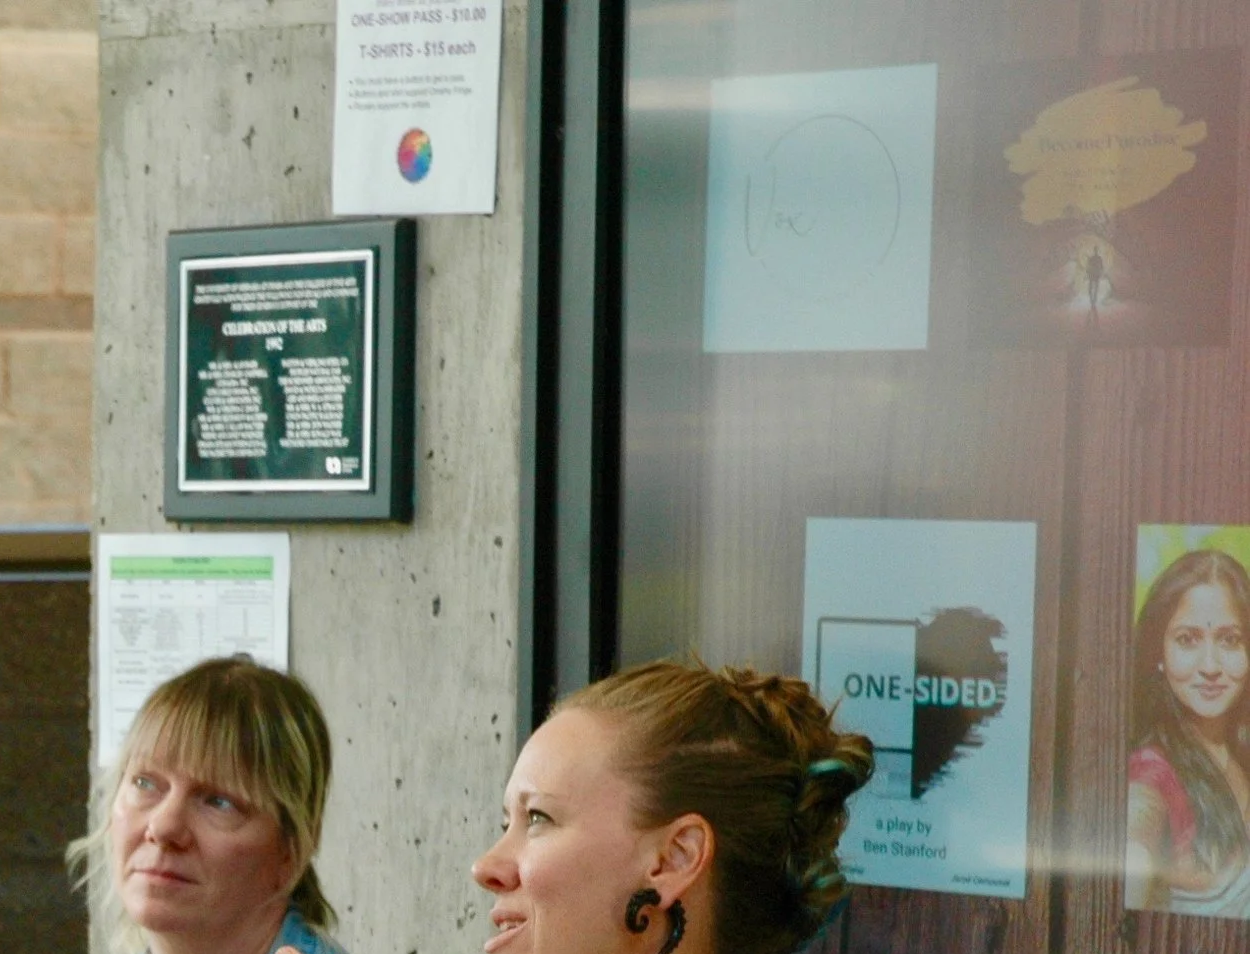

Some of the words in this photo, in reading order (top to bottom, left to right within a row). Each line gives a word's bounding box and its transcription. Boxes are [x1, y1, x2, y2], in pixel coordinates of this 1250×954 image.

[351, 11, 410, 27] ONE-SHOW
[413, 9, 442, 24] PASS
[451, 7, 486, 22] $10.00
[359, 42, 414, 59] T-SHIRTS
[423, 40, 446, 57] $15
[448, 40, 477, 55] each
[844, 674, 997, 708] ONE-SIDED
[886, 816, 914, 837] play
[916, 818, 932, 836] by
[863, 839, 887, 854] Ben
[891, 841, 947, 860] Stanford
